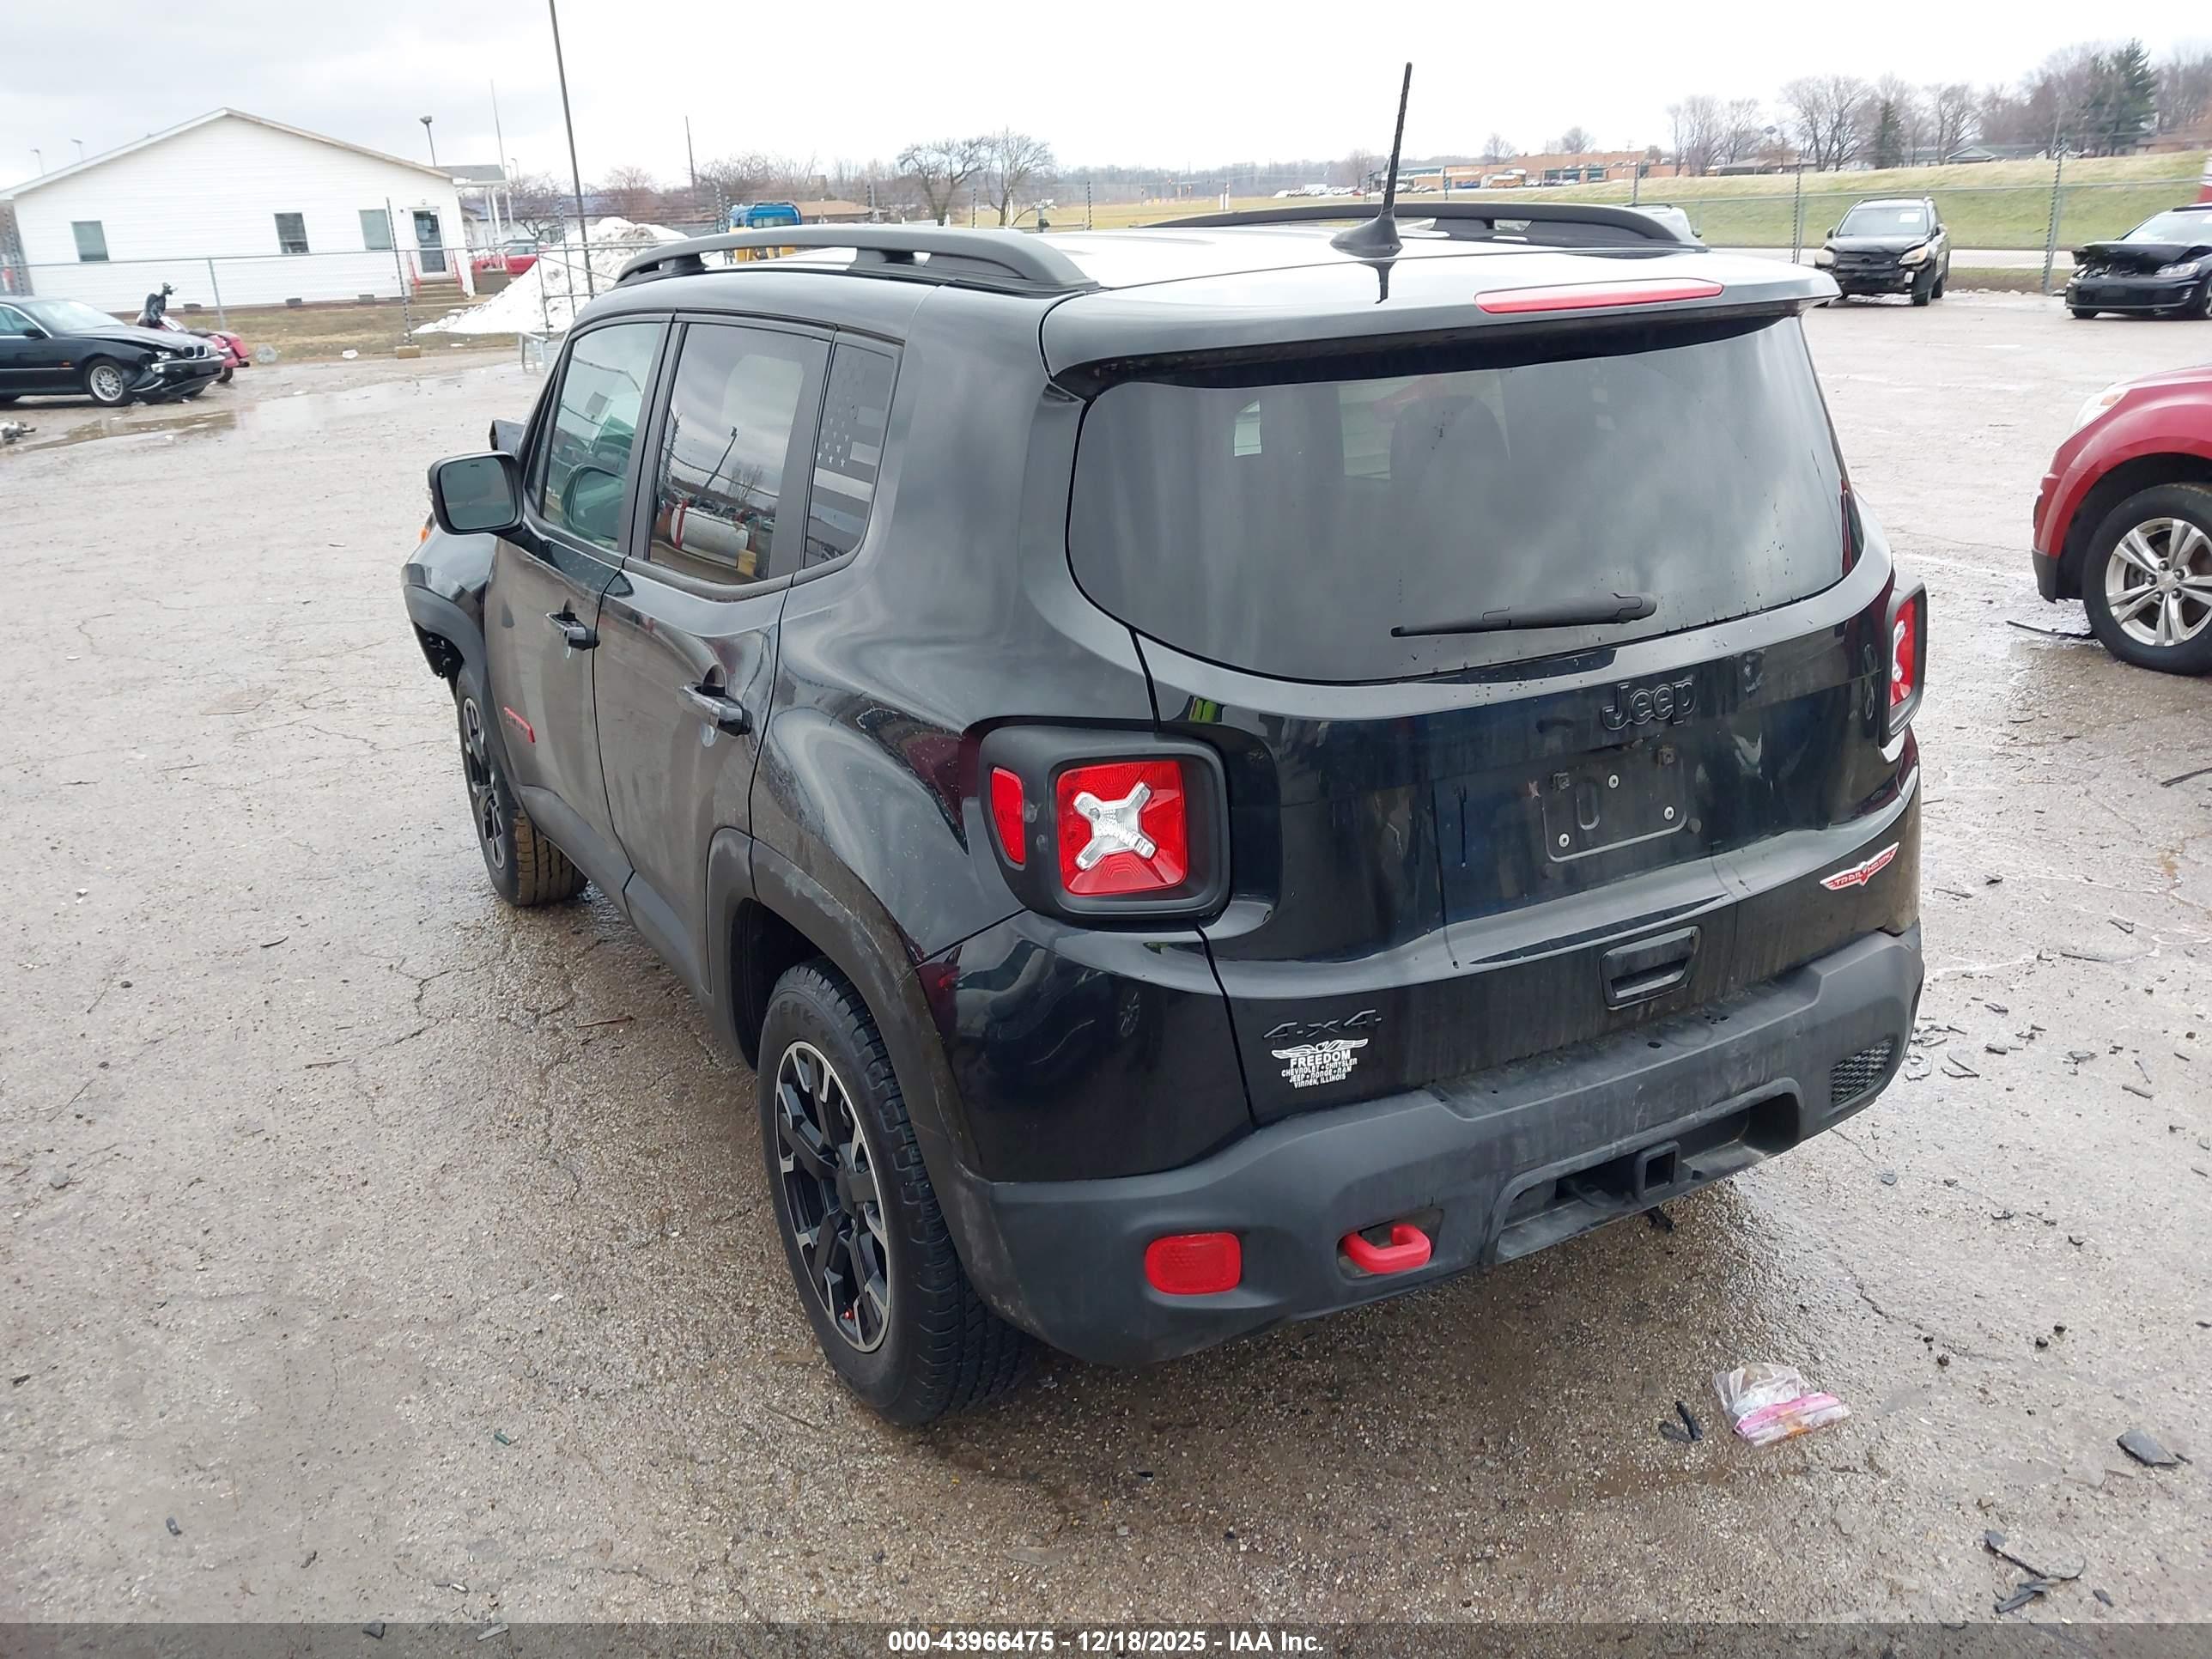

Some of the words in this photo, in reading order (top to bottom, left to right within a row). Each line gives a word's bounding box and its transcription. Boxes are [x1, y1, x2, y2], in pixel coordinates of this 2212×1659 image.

[1602, 677, 1697, 731] Jeep
[1281, 1065, 1320, 1077] CHEVROLET
[1325, 1057, 1358, 1070] CHRYSLER
[1290, 1049, 1351, 1068] FREEDOM
[1321, 1073, 1346, 1084] ILLINOIS
